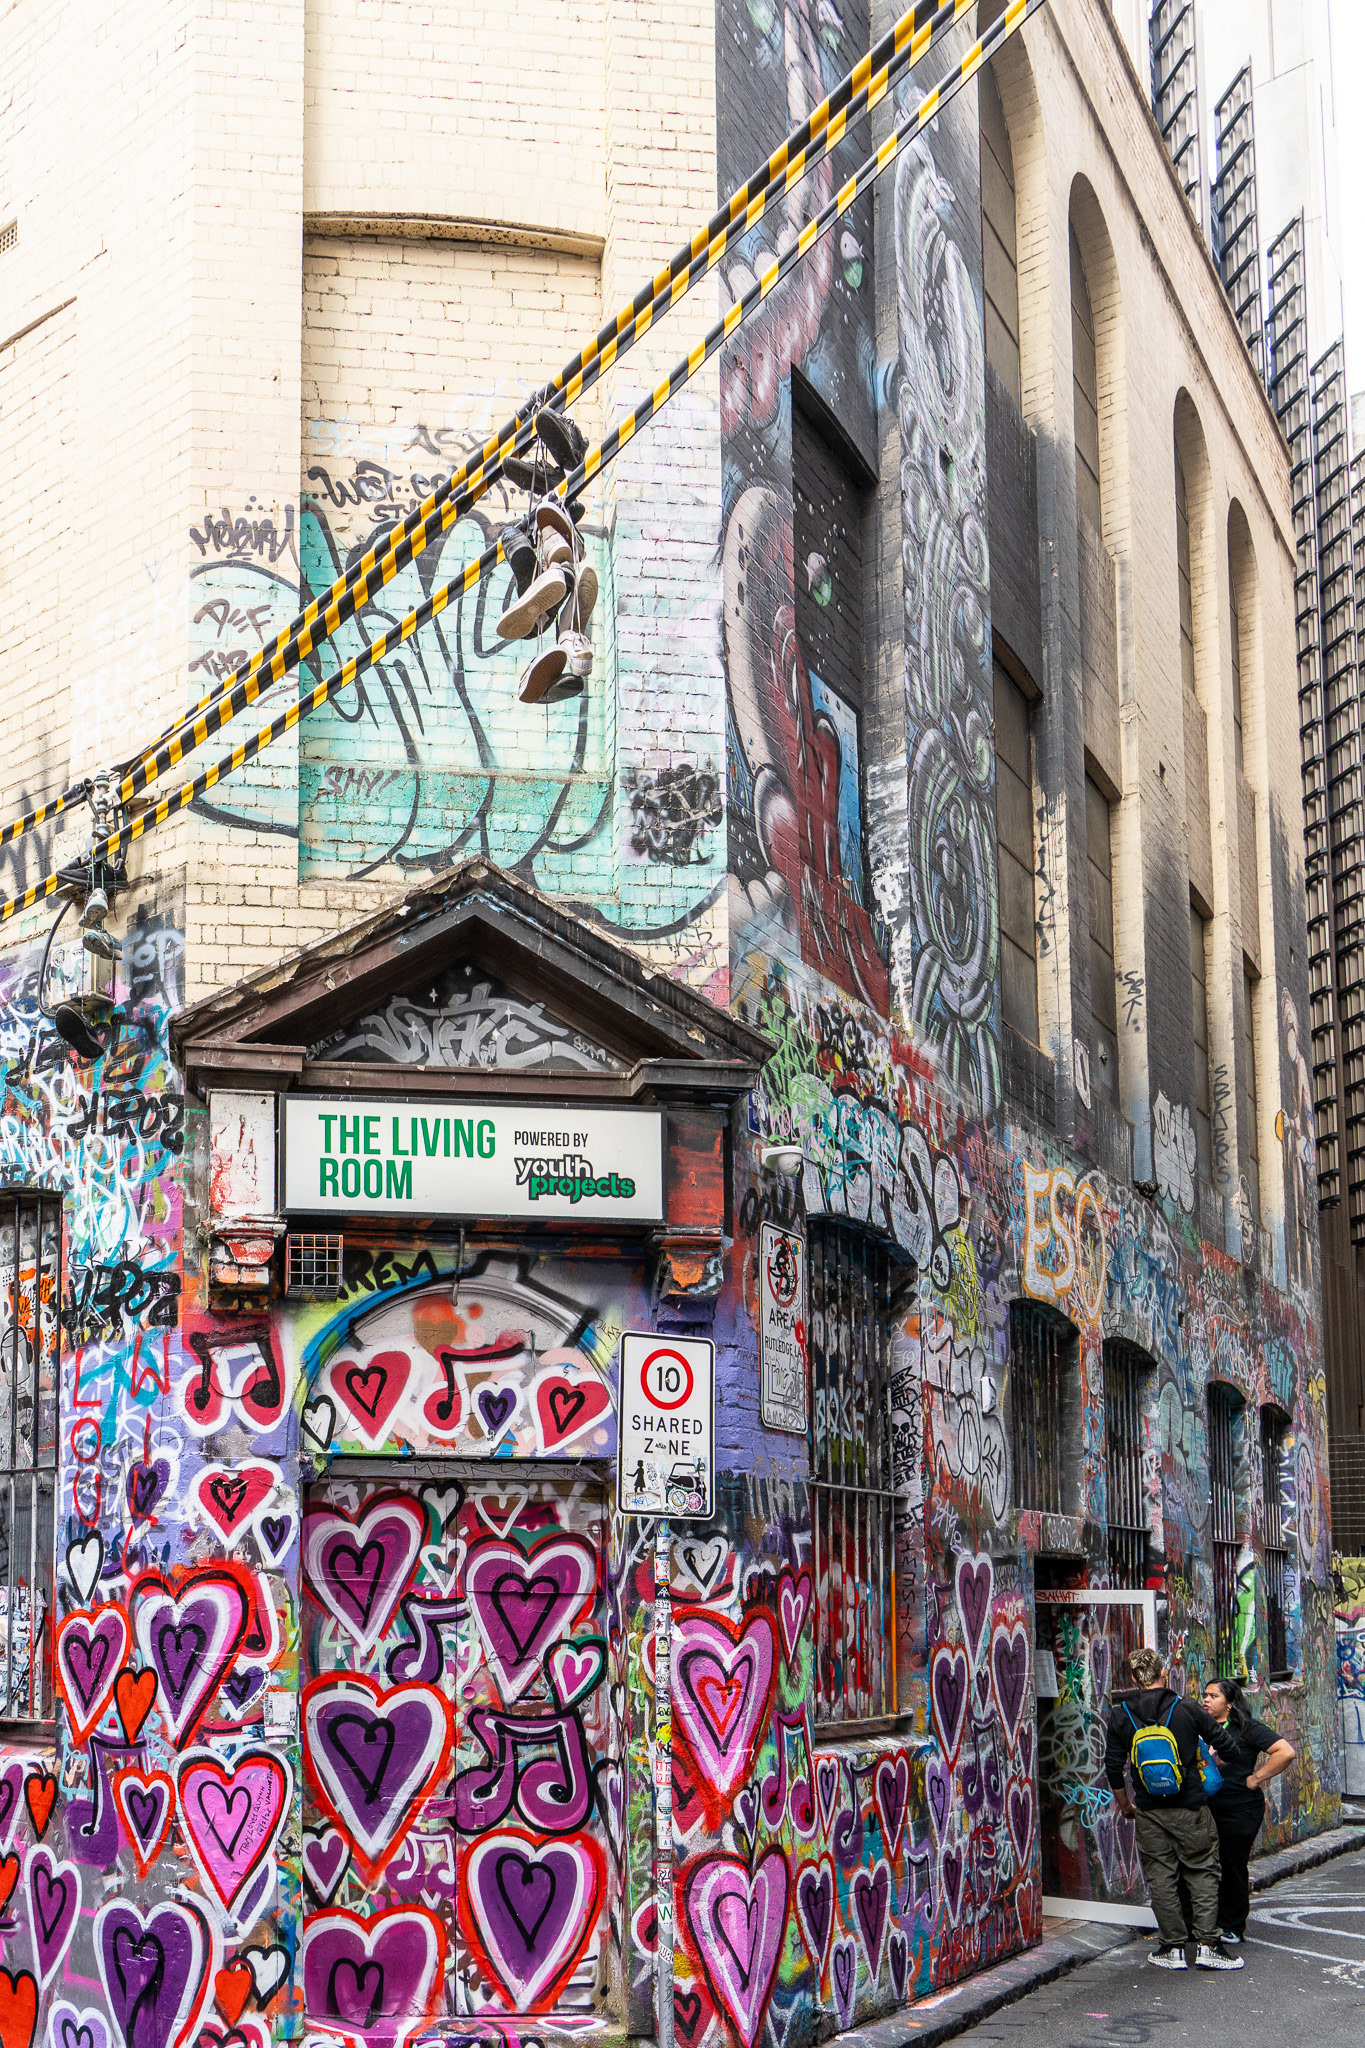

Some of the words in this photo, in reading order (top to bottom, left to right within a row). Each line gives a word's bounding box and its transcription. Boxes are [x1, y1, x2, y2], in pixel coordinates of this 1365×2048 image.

[318, 1114, 381, 1155] THE
[392, 1117, 496, 1159] LIVING
[514, 1130, 570, 1147] POWERED
[573, 1132, 589, 1148] BY
[319, 1157, 413, 1200] ROOM
[514, 1154, 594, 1185] youth
[528, 1172, 637, 1204] projects
[768, 1308, 796, 1329] AREA
[765, 1336, 793, 1356] RUTLEDGE
[657, 1366, 680, 1392] 10
[632, 1415, 702, 1434] SHARED
[644, 1438, 690, 1456] ZNE
